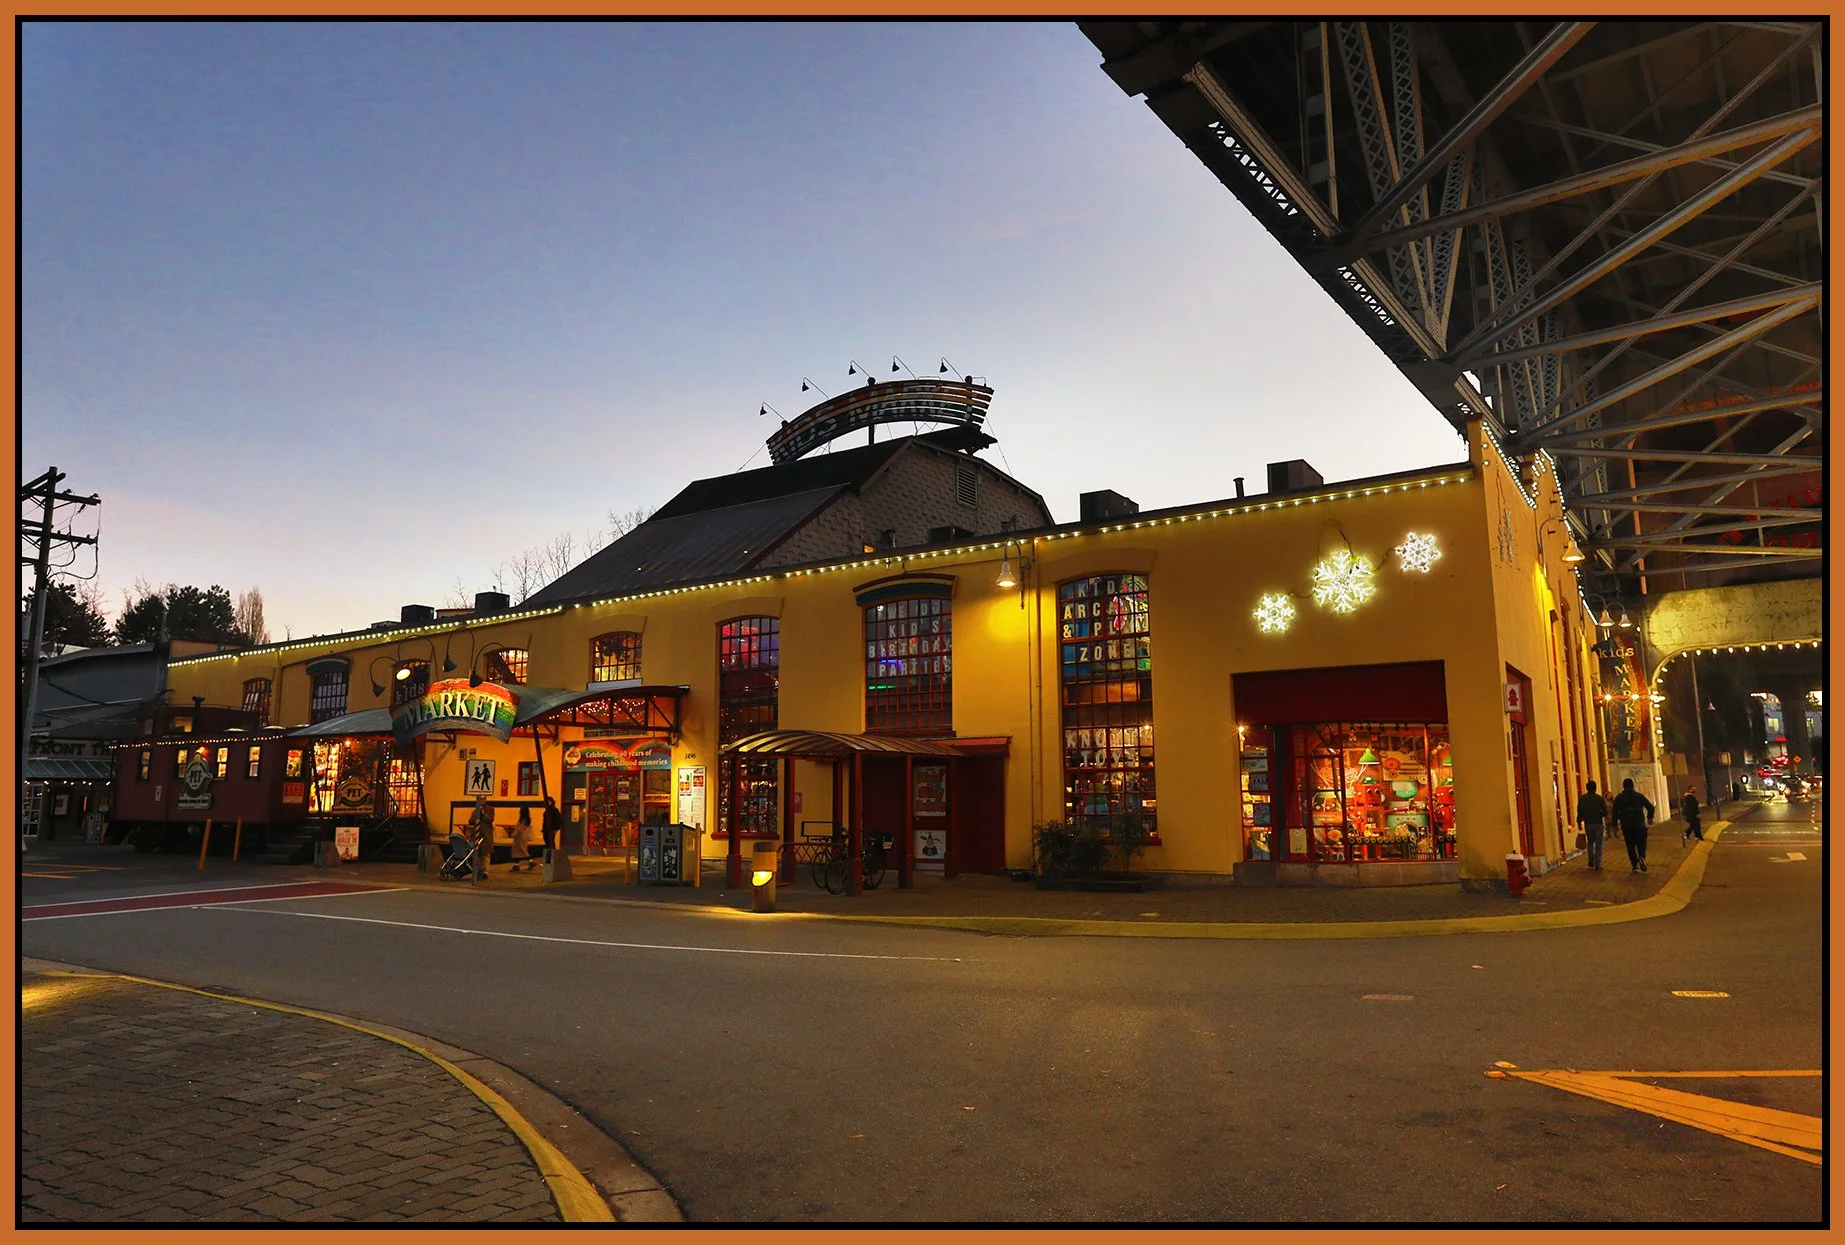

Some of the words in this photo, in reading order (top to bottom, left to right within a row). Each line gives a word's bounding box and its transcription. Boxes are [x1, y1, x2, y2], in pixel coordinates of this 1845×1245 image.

[1062, 623, 1073, 638] &
[868, 638, 951, 659] BIRTHDAY
[1080, 643, 1131, 662] ZONE
[1597, 647, 1635, 658] kids
[879, 658, 951, 677] PARTIES
[395, 683, 425, 705] kids
[403, 691, 505, 730] MARKET
[585, 751, 619, 759] Celebrating
[585, 760, 607, 768] making
[608, 759, 637, 767] childhood
[638, 758, 668, 766] memories
[346, 788, 362, 797] PET
